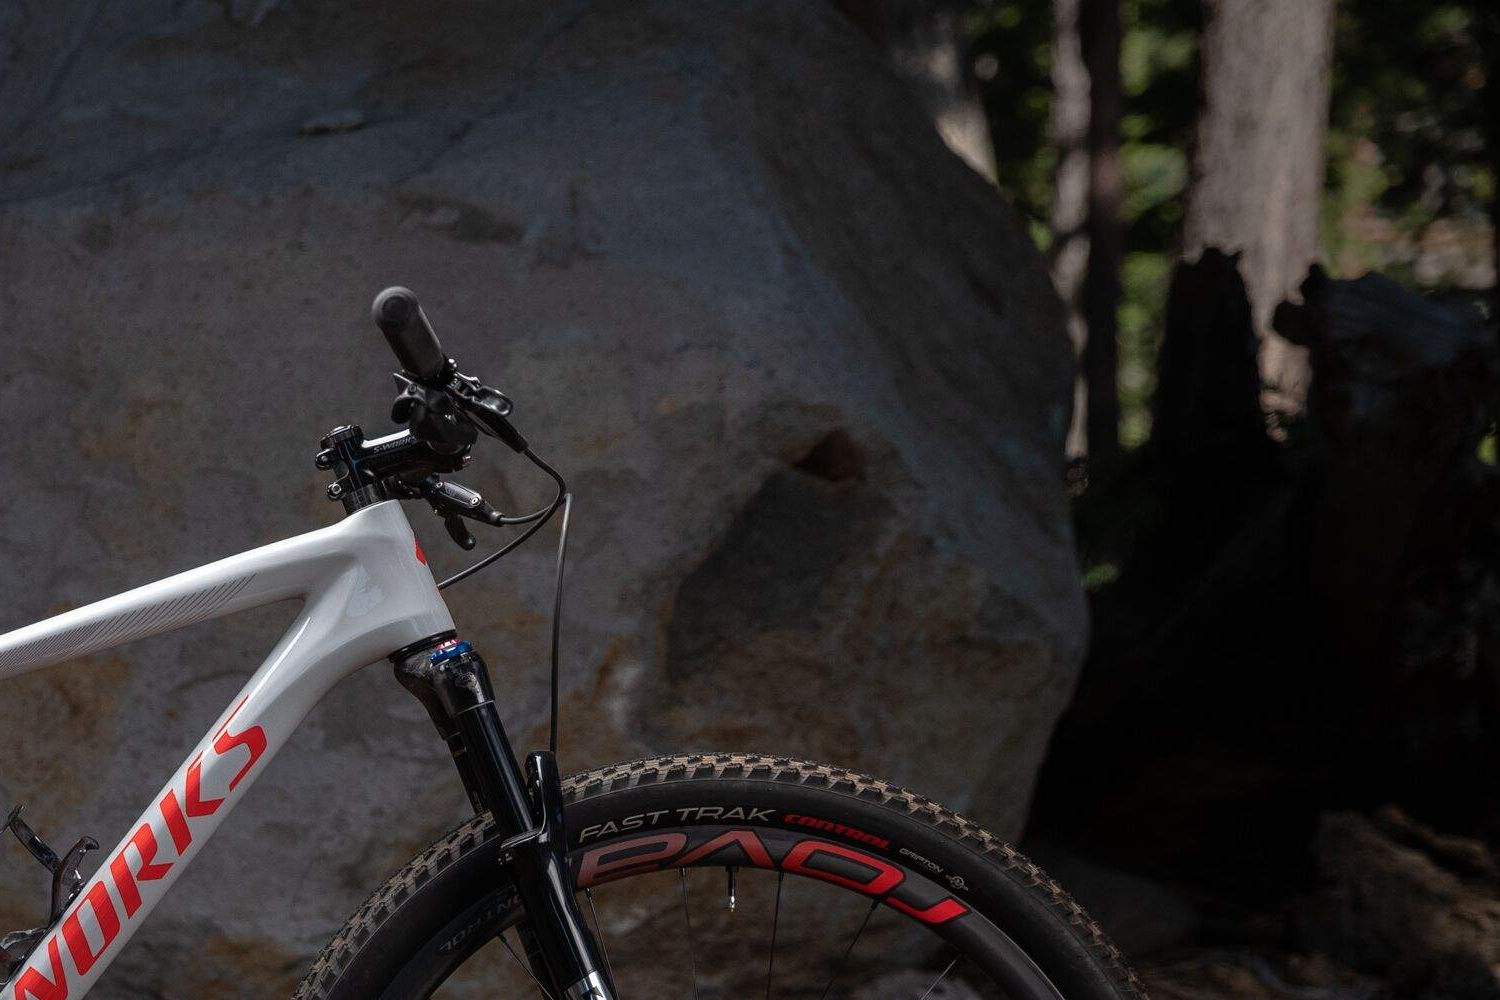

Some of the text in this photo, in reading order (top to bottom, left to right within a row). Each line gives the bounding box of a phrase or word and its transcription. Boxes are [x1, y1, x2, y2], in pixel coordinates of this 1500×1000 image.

[578, 809, 670, 844] FAST
[675, 806, 779, 822] TRAK
[575, 829, 972, 926] rova
